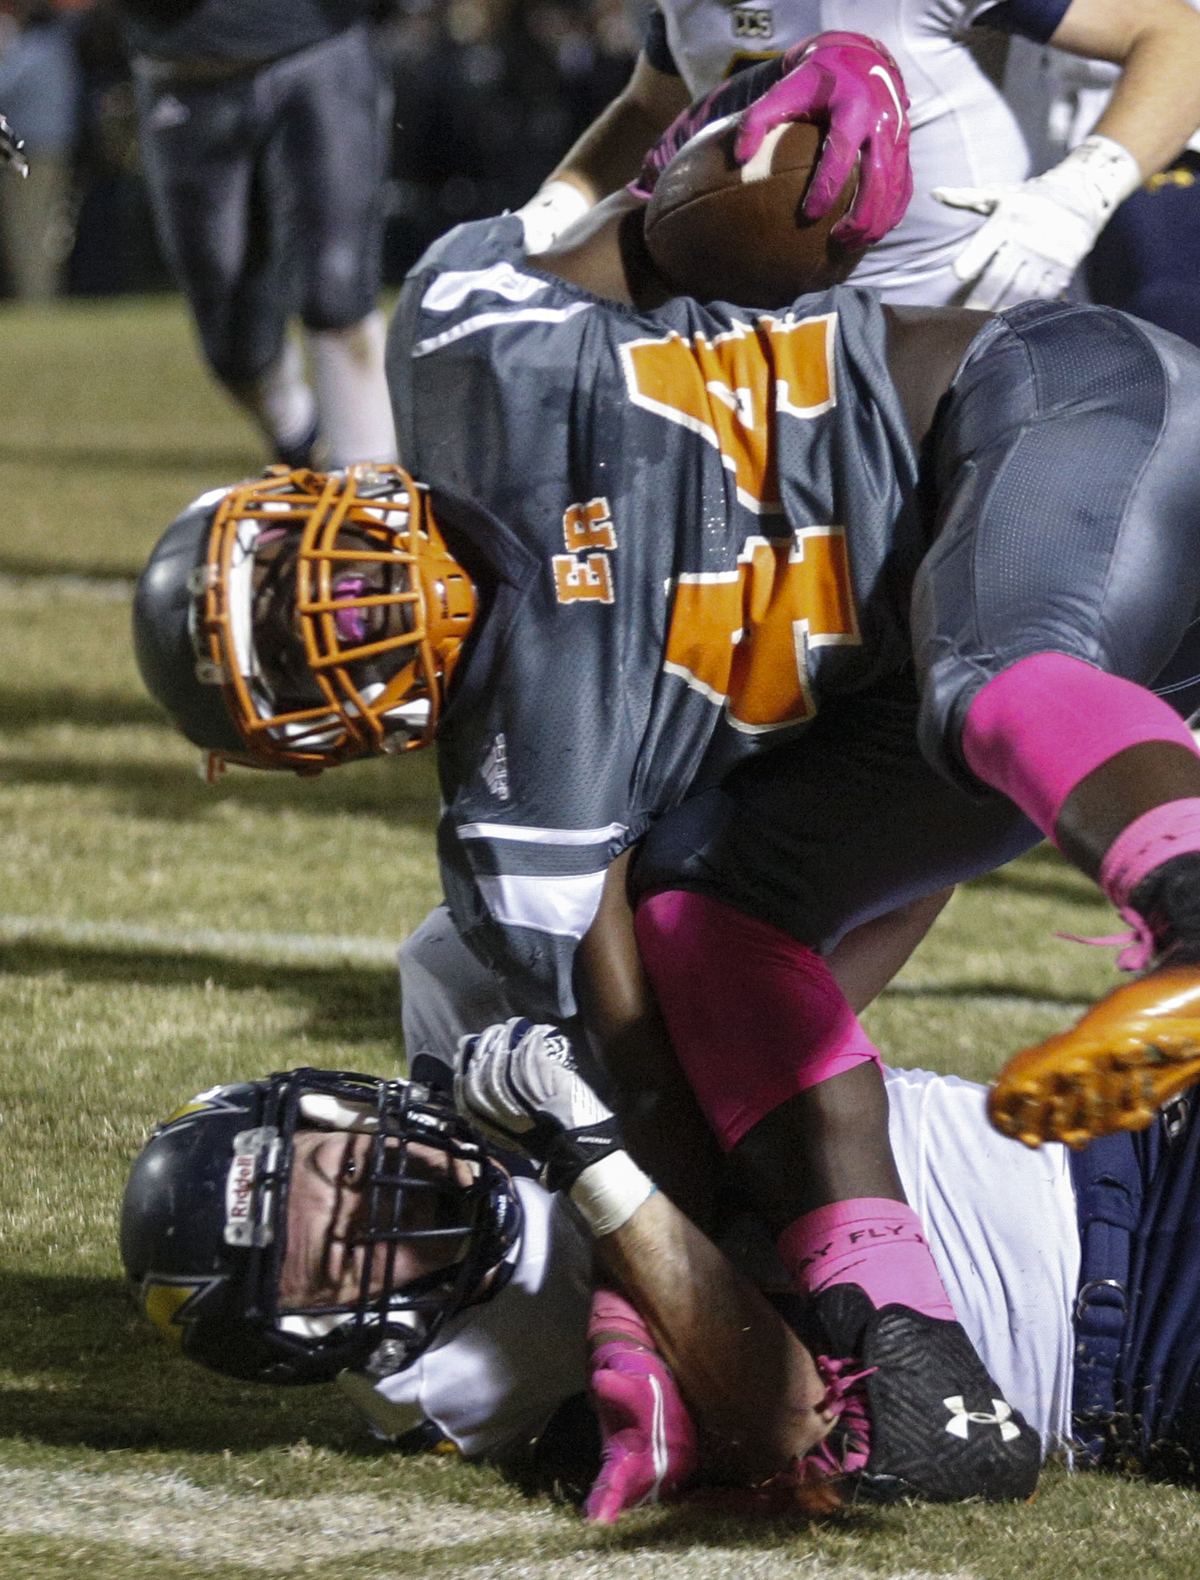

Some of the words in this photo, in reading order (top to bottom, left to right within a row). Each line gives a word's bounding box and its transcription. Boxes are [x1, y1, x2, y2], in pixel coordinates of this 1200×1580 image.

[551, 496, 618, 605] ER
[618, 312, 862, 735] 44
[230, 1156, 254, 1219] Riddell
[848, 1225, 905, 1245] FLY
